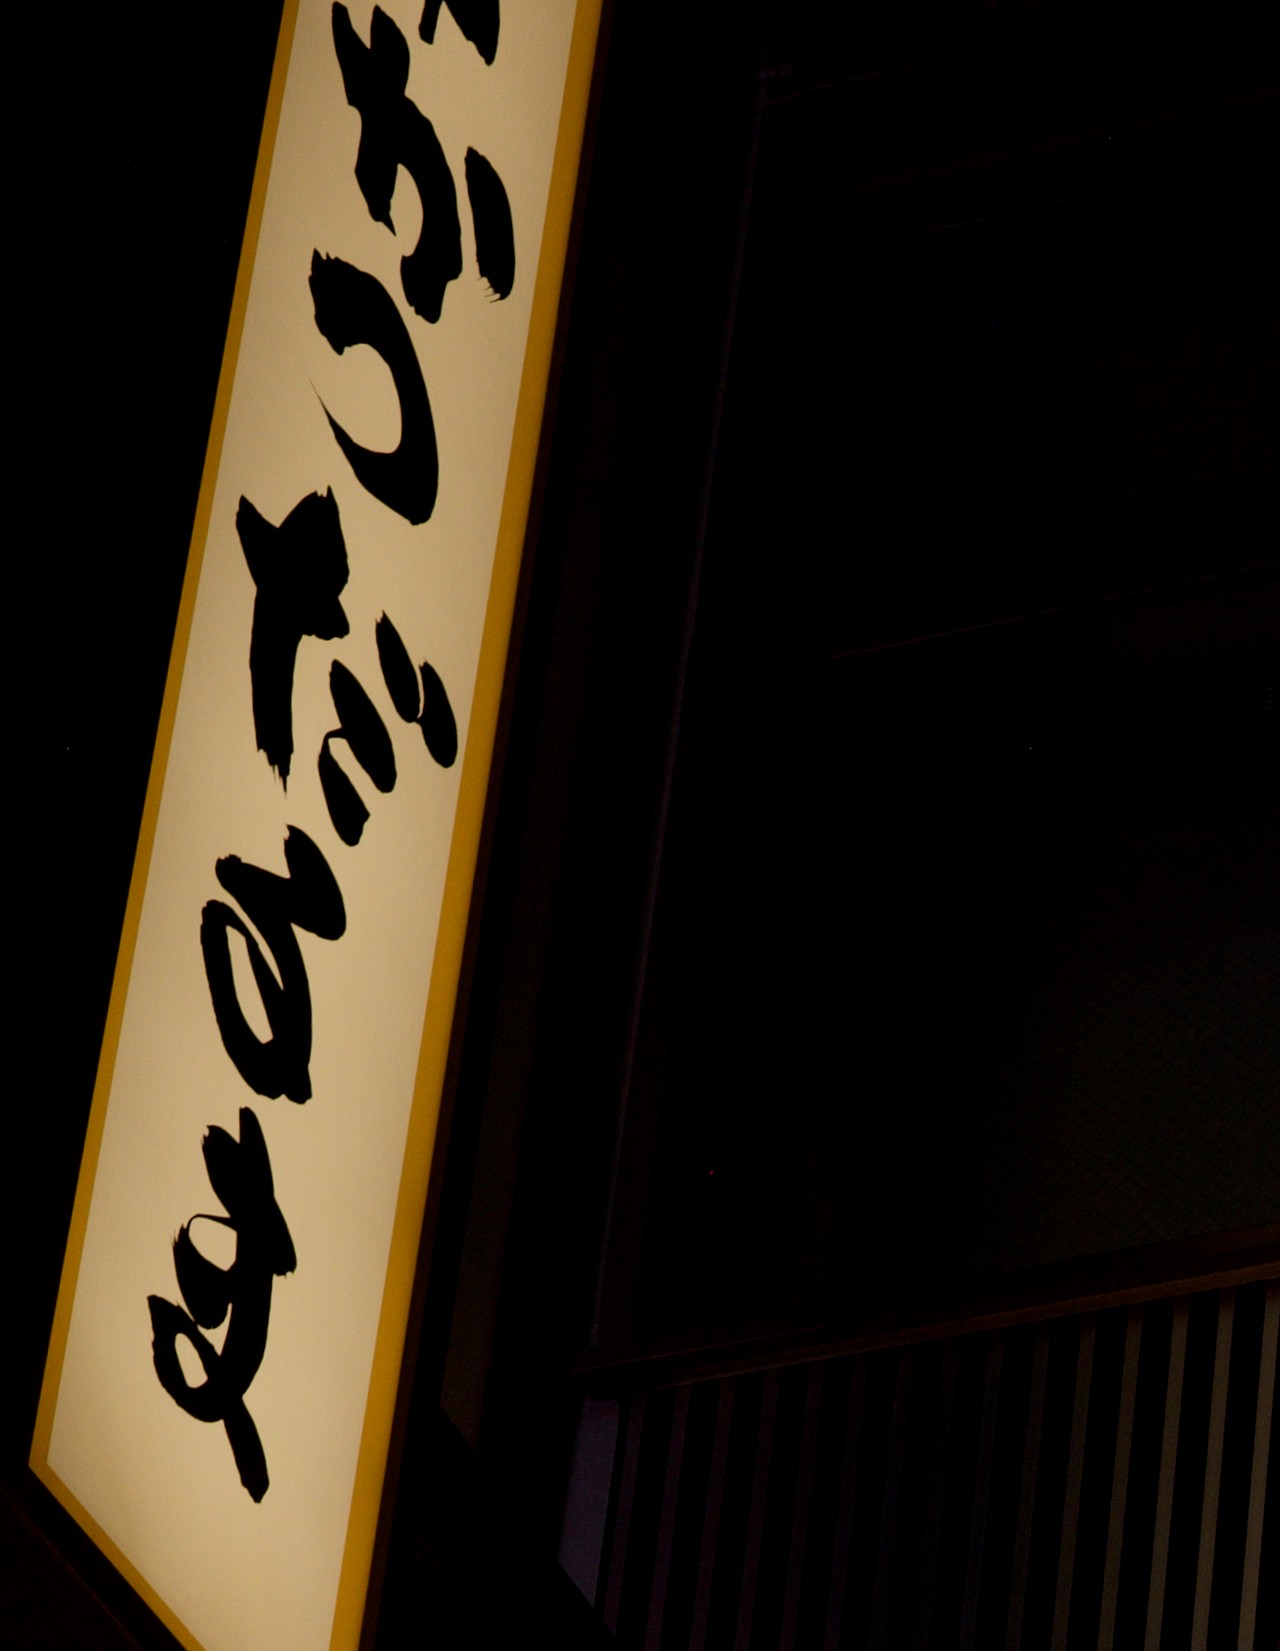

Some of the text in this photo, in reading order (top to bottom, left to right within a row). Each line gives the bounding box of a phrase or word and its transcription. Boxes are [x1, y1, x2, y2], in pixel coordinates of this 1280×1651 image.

[148, 0, 515, 1503] かつだるま
